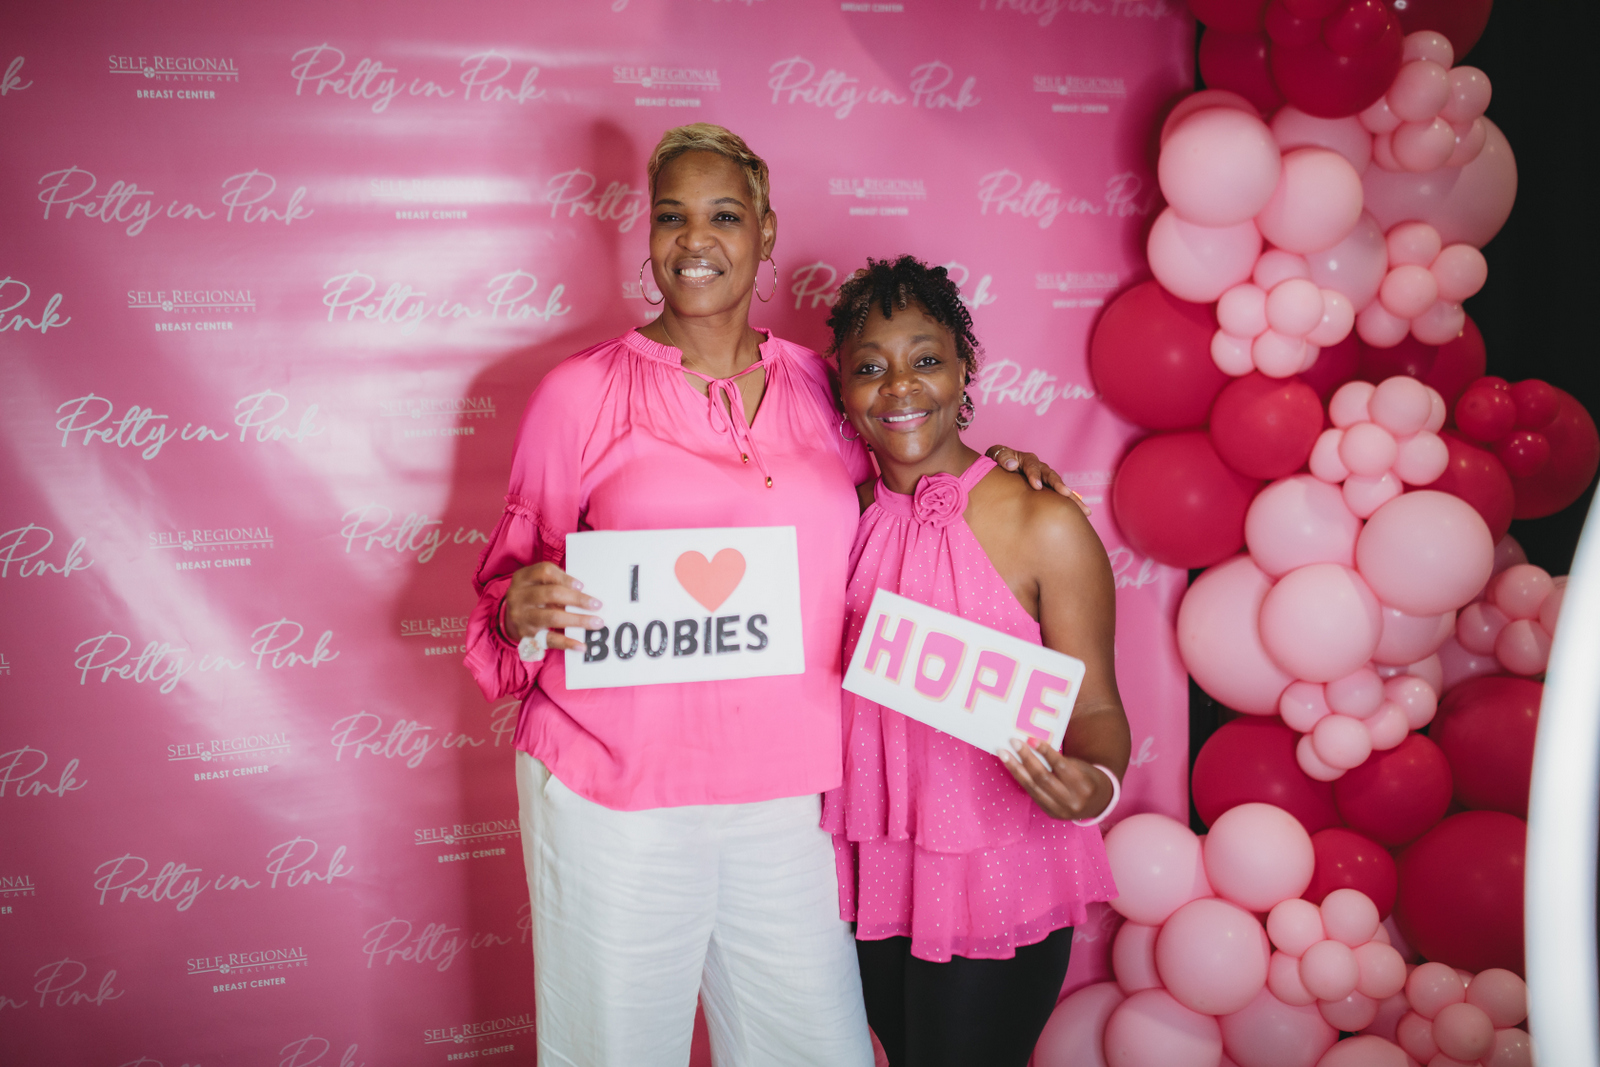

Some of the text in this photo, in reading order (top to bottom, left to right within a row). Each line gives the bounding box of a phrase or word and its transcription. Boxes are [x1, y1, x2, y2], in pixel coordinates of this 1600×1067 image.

[108, 55, 239, 71] SELF REGIONAL
[612, 66, 720, 81] SELF REGIONAL
[155, 75, 240, 83] HEALTHCARE
[291, 43, 546, 113] Pretty in Pink
[768, 56, 982, 120] Pretty in Pink
[136, 90, 216, 99] BREAST CENTER
[38, 165, 314, 237] Pretty in Pink
[546, 168, 651, 233] Pretty
[977, 168, 1063, 229] Pretty
[1065, 197, 1102, 215] in
[395, 210, 468, 220] BREAST CENTER
[127, 290, 256, 304] SELF REGIONAL
[322, 269, 571, 335] Pretty in Pink
[173, 306, 257, 314] HEALTHCARE
[155, 321, 234, 332] BREAST CENTER
[980, 359, 1095, 416] Pretty in
[420, 396, 497, 411] REGIONAL
[56, 389, 327, 460] Pretty in Pink
[440, 426, 475, 436] CENTER
[149, 527, 274, 546] SELF REGIONAL
[341, 501, 489, 564] Pretty in
[0, 523, 94, 578] Pink
[193, 542, 274, 553] HEALTHCARE
[175, 557, 252, 571] BREAST CENTER
[629, 564, 639, 602] I
[400, 619, 435, 632] SELF
[583, 613, 769, 664] BOOBIES
[74, 617, 340, 694] Pretty in Pink
[424, 645, 458, 656] BREAST
[861, 611, 1072, 742] HOPE
[167, 732, 290, 758] SELF REGIONAL
[330, 710, 486, 769] Pretty in
[194, 764, 270, 782] BREAST CENTER
[414, 819, 520, 841] SELF REGIONA
[438, 847, 506, 863] BREAST CENTER
[94, 836, 354, 912] Pretty in Pink
[362, 916, 512, 972] Pretty in
[187, 947, 308, 972] SELF REGIONAL
[230, 960, 308, 975] HEALTHCARE
[34, 957, 125, 1008] Pink
[213, 976, 287, 993] BREAST CENTER
[424, 1013, 535, 1041] SELF REGIONAL
[447, 1044, 515, 1061] BREAST CENTER
